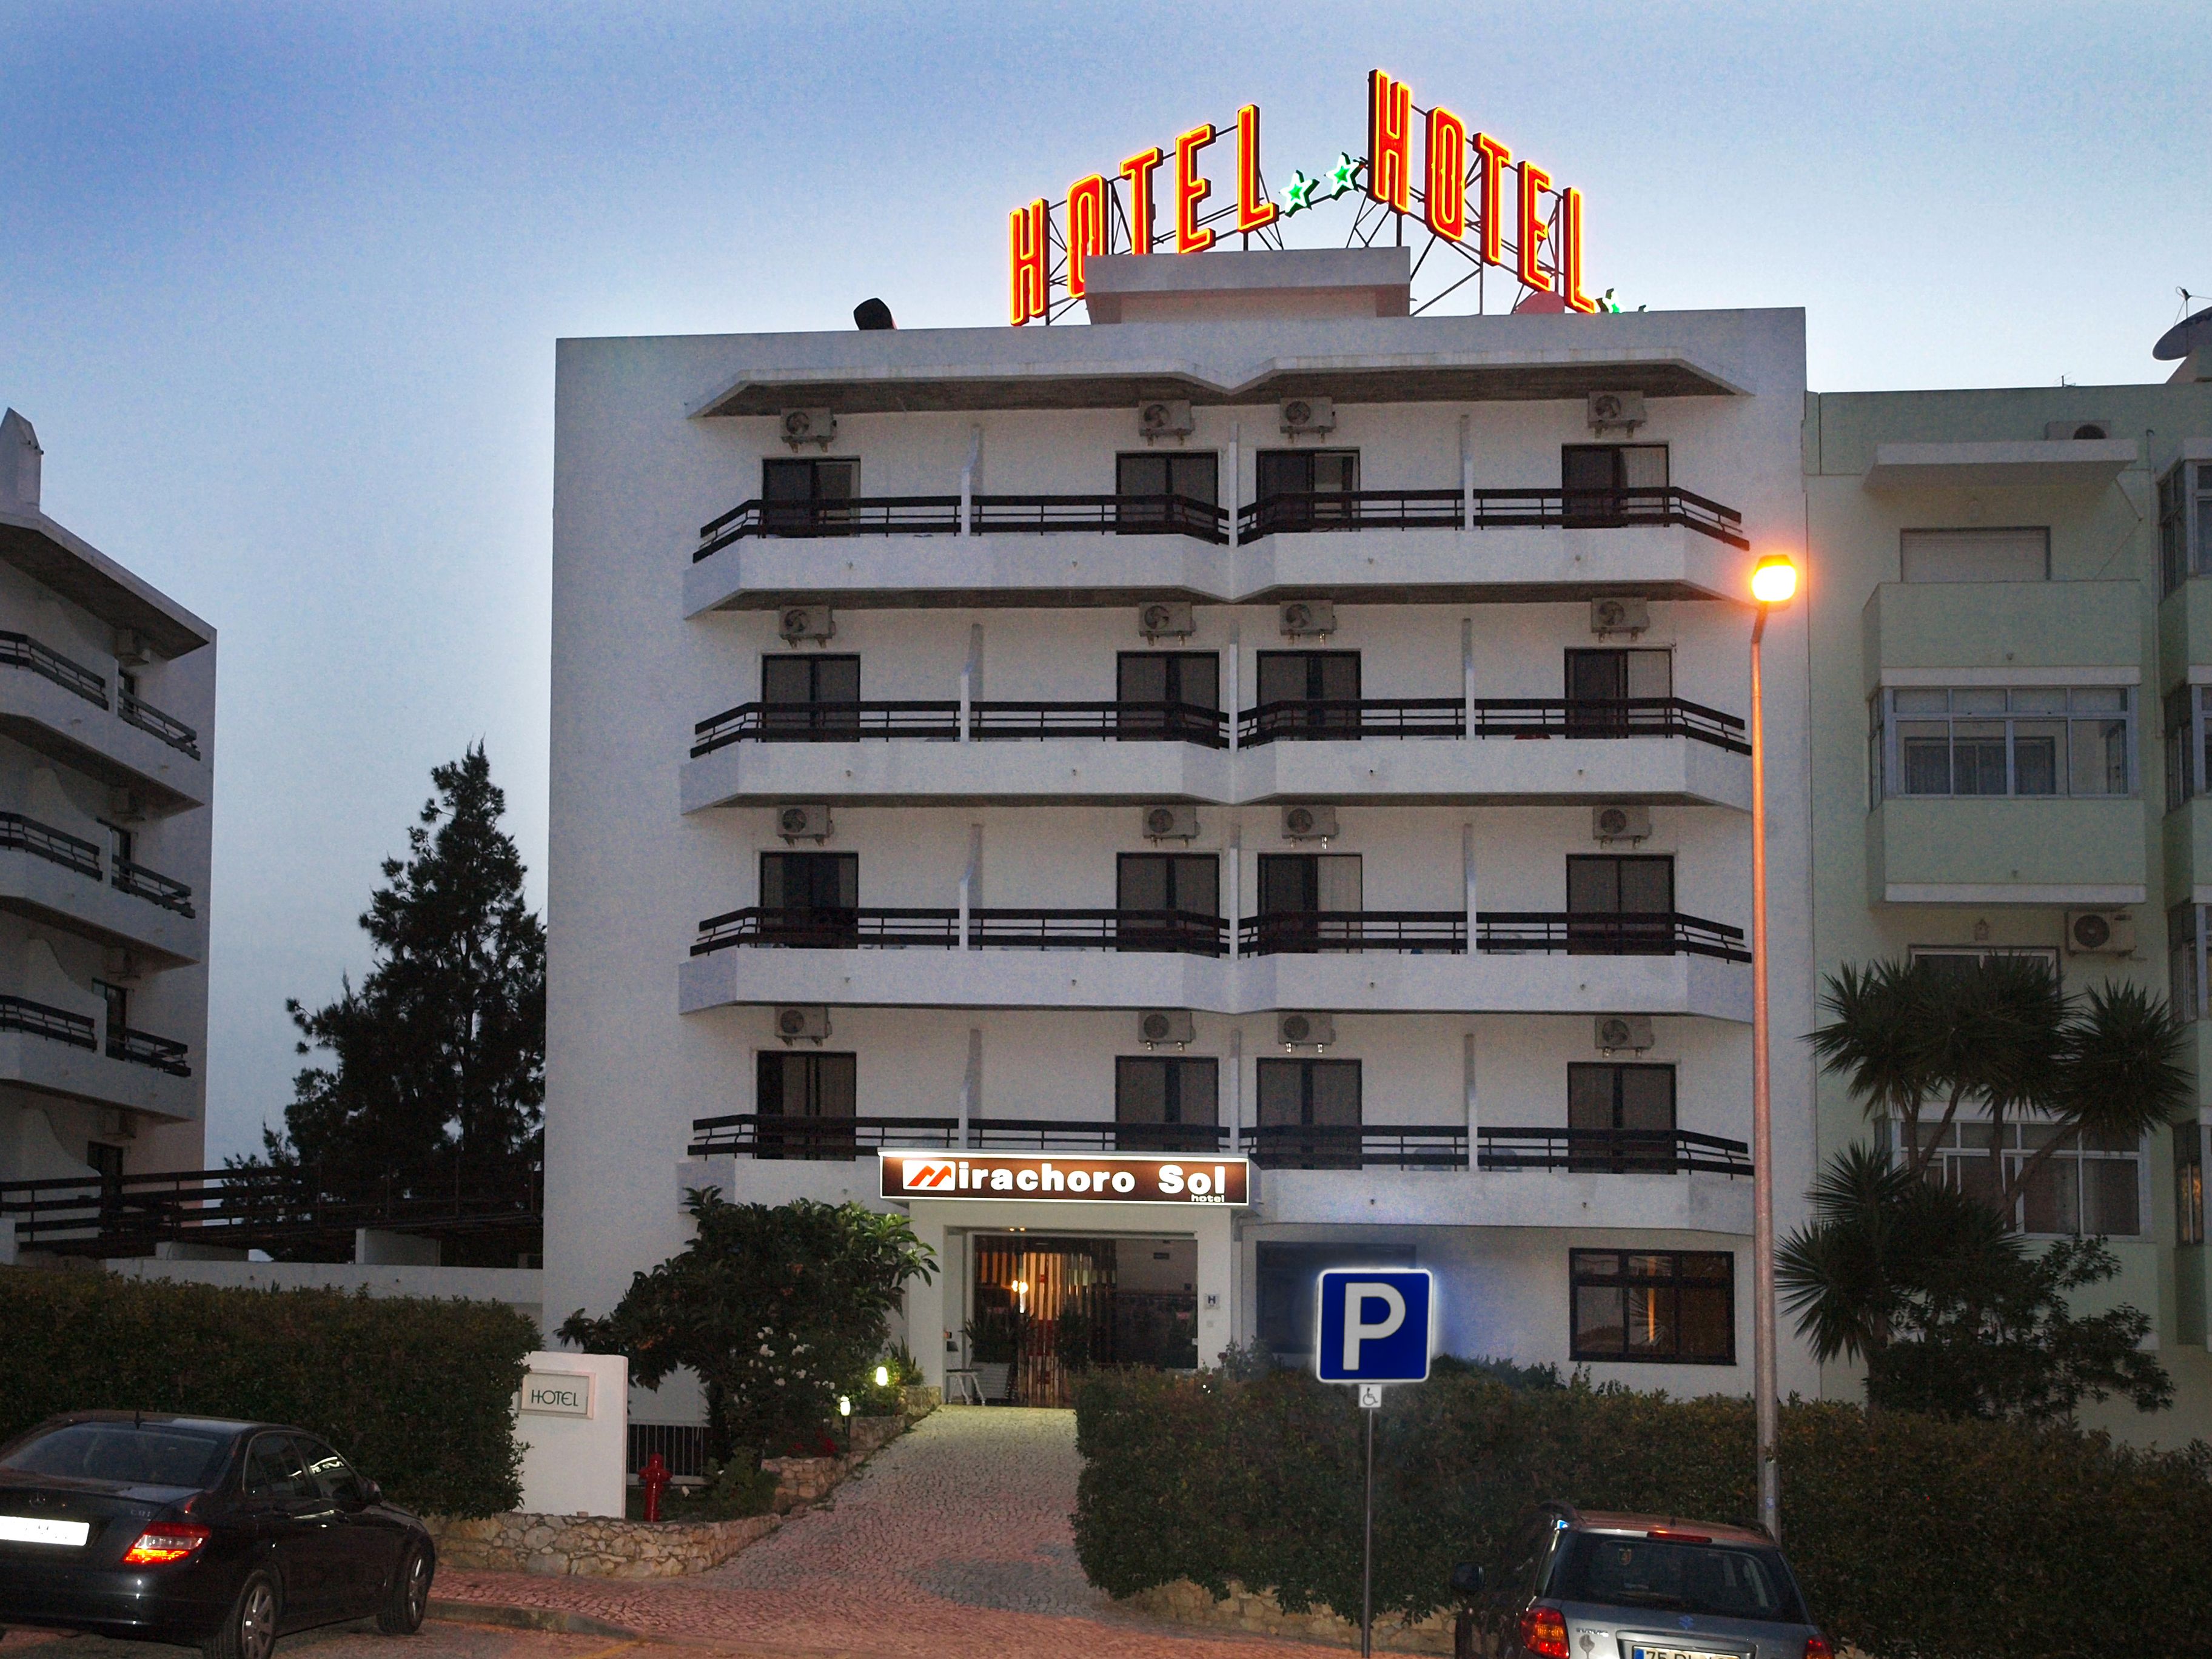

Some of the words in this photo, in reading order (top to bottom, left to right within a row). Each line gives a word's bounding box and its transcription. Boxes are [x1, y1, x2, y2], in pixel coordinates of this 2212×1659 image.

[1367, 69, 1598, 314] HOTEL
[1010, 103, 1279, 326] HOTEL
[906, 1161, 1135, 1193] Mirachoro
[1158, 1164, 1225, 1195] Sol
[1191, 1194, 1225, 1202] hotel
[1207, 1295, 1216, 1304] H
[1342, 1282, 1406, 1371] P
[531, 1389, 578, 1407] HOTEL
